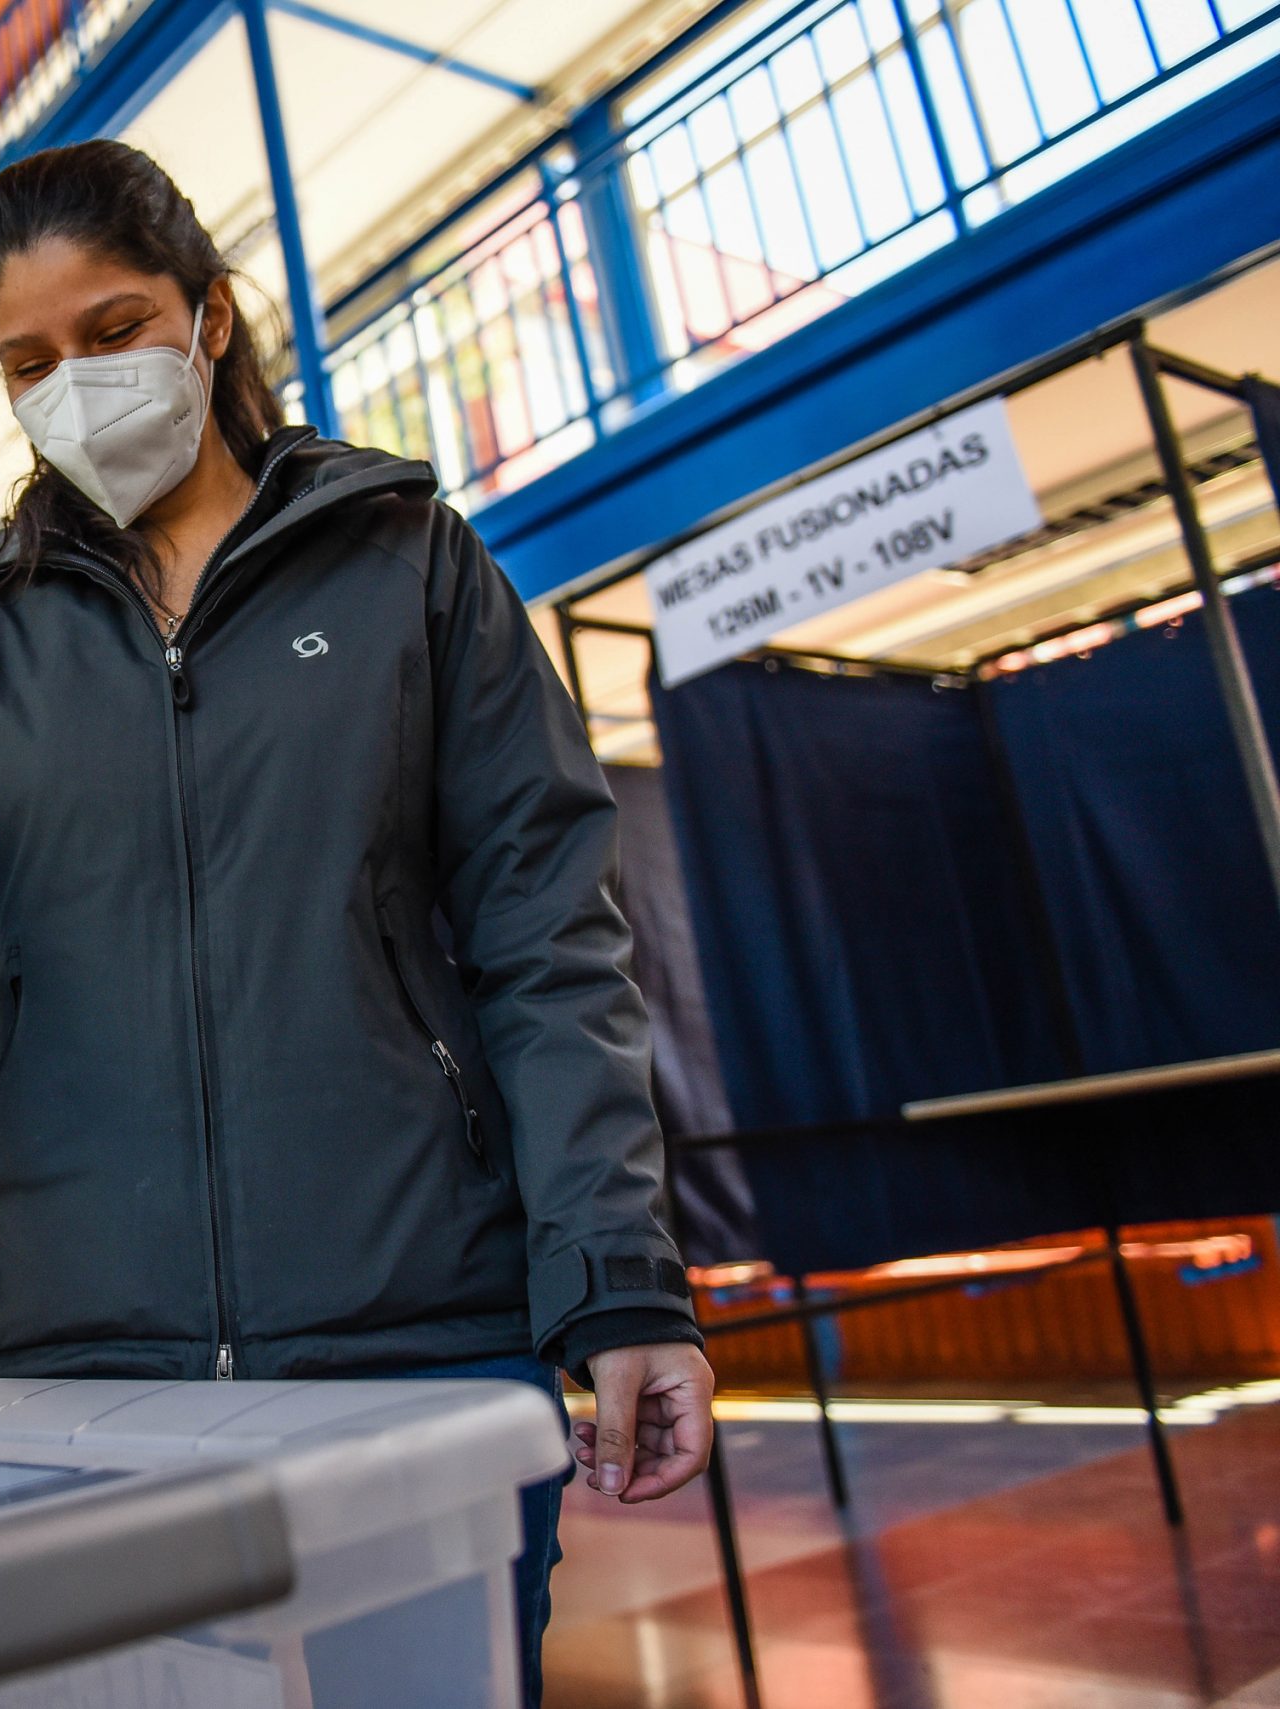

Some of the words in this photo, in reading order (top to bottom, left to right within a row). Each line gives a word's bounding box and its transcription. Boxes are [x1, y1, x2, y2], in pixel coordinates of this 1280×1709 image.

[658, 543, 753, 609] MESAS
[758, 433, 988, 558] FUSIONADAS
[806, 560, 846, 596] 1V
[873, 509, 954, 566] 108V
